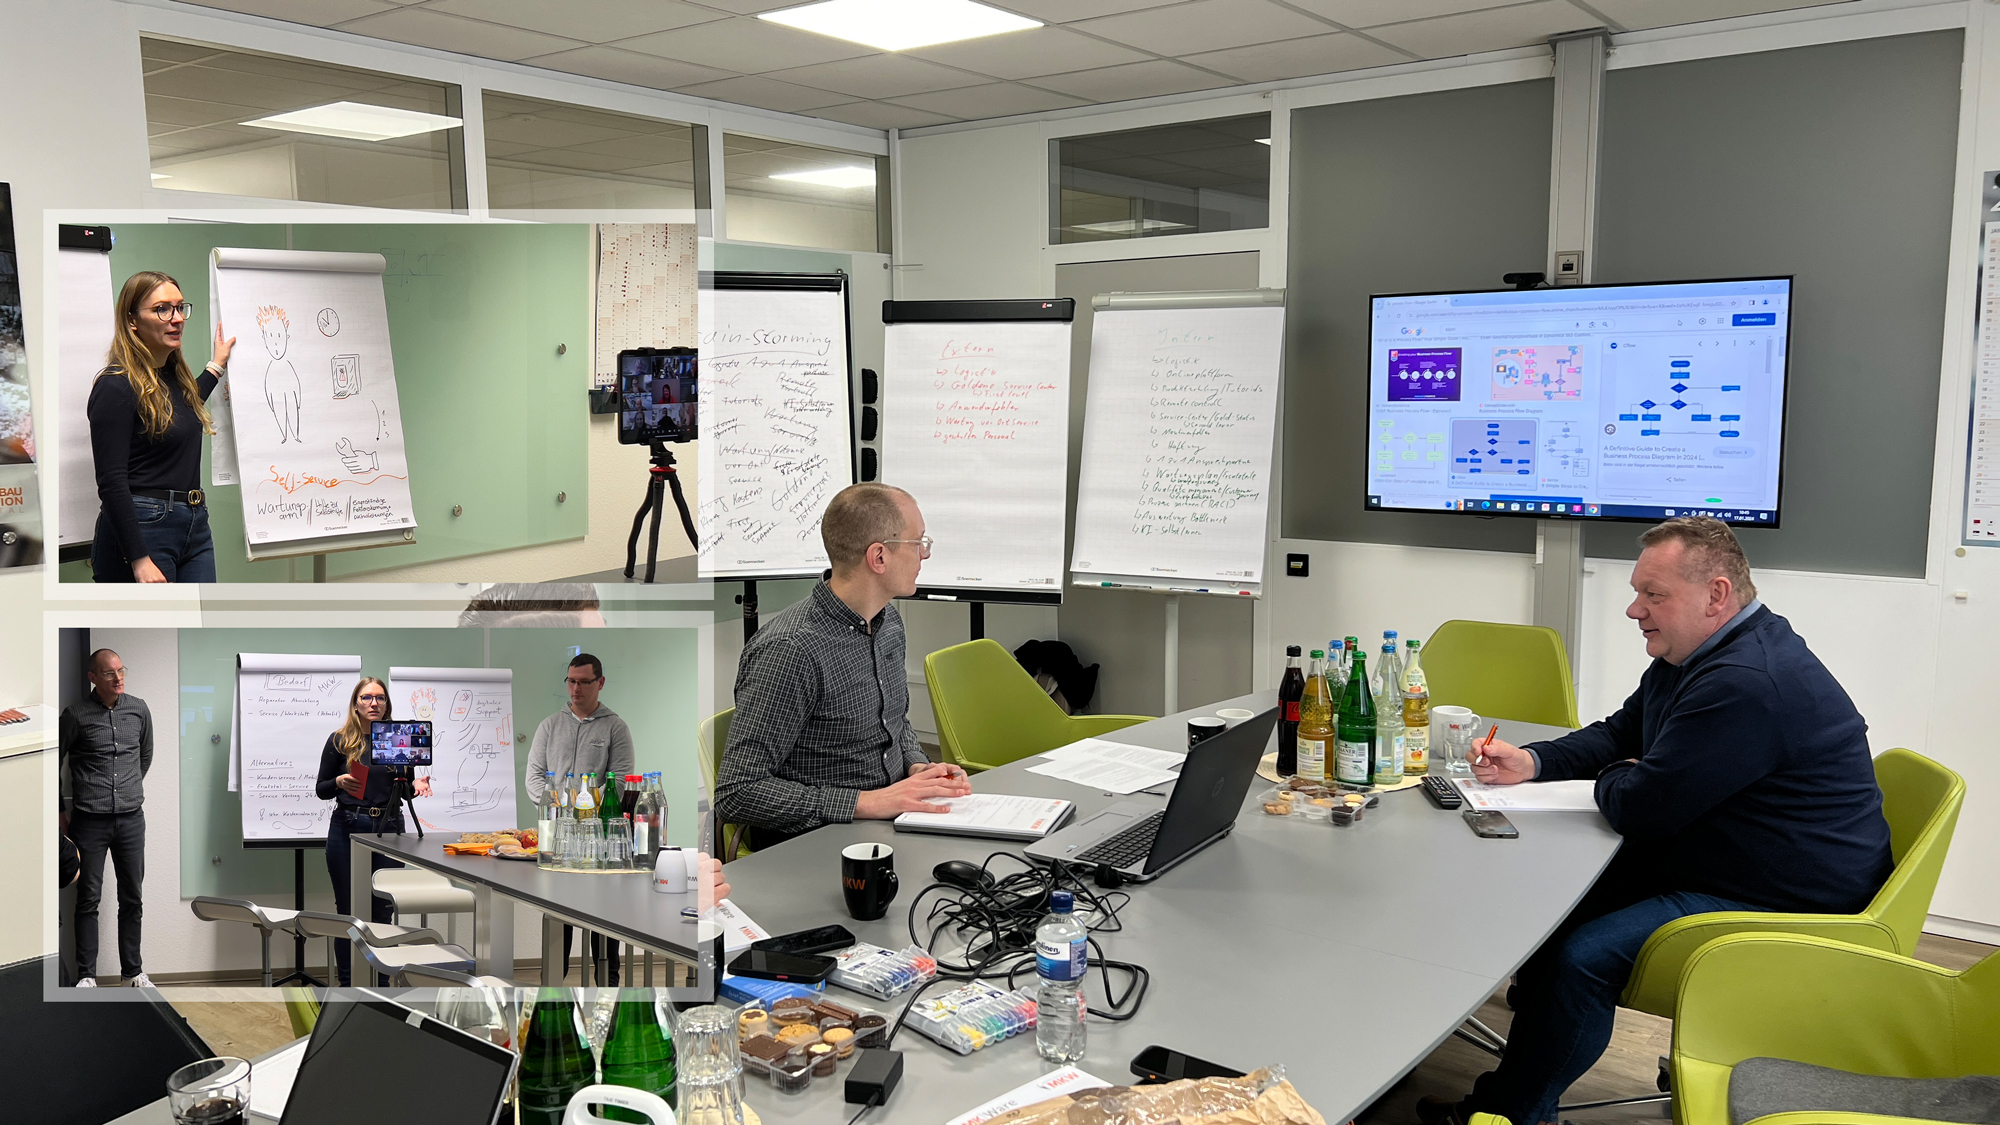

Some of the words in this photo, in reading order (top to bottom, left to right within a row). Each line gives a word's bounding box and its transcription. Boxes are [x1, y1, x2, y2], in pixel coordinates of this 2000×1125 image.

[1401, 327, 1426, 336] Google
[698, 324, 831, 356] ain-Storming
[270, 465, 339, 494] Self-Service
[318, 676, 336, 692] MKW
[476, 707, 502, 719] Support
[1047, 1072, 1079, 1088] MKW
[983, 1100, 1018, 1118] Ware
